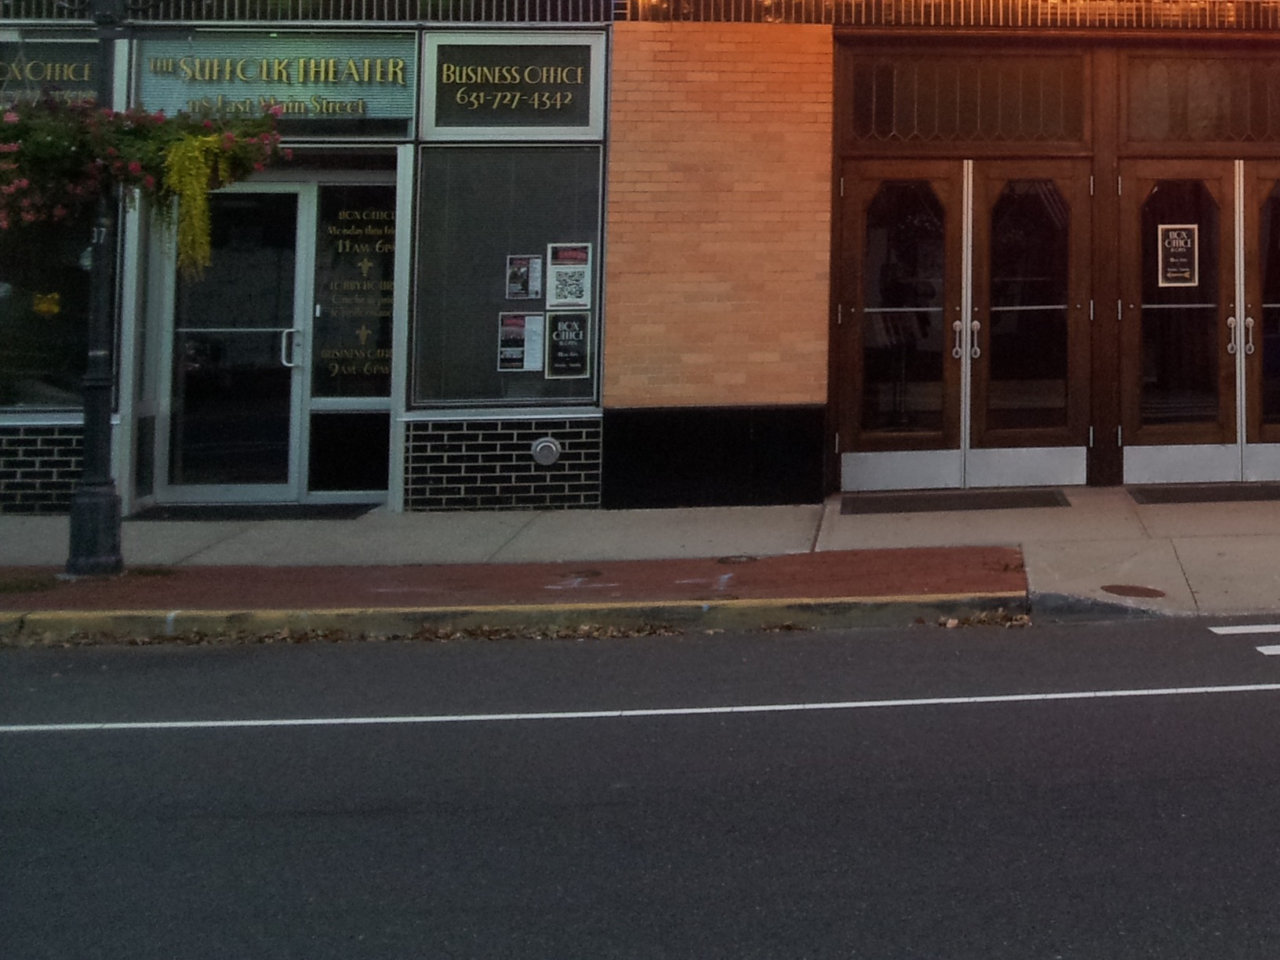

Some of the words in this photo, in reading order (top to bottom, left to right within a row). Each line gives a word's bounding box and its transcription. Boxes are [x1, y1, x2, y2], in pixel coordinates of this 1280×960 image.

[25, 60, 91, 82] OFFICE
[149, 57, 173, 73] THE
[179, 56, 291, 83] SUFFOLK
[298, 57, 406, 85] THEATER
[441, 63, 521, 84] BUSINESS
[524, 66, 584, 84] OFFICE
[311, 95, 366, 113] Street
[456, 86, 573, 110] 631-727-4342
